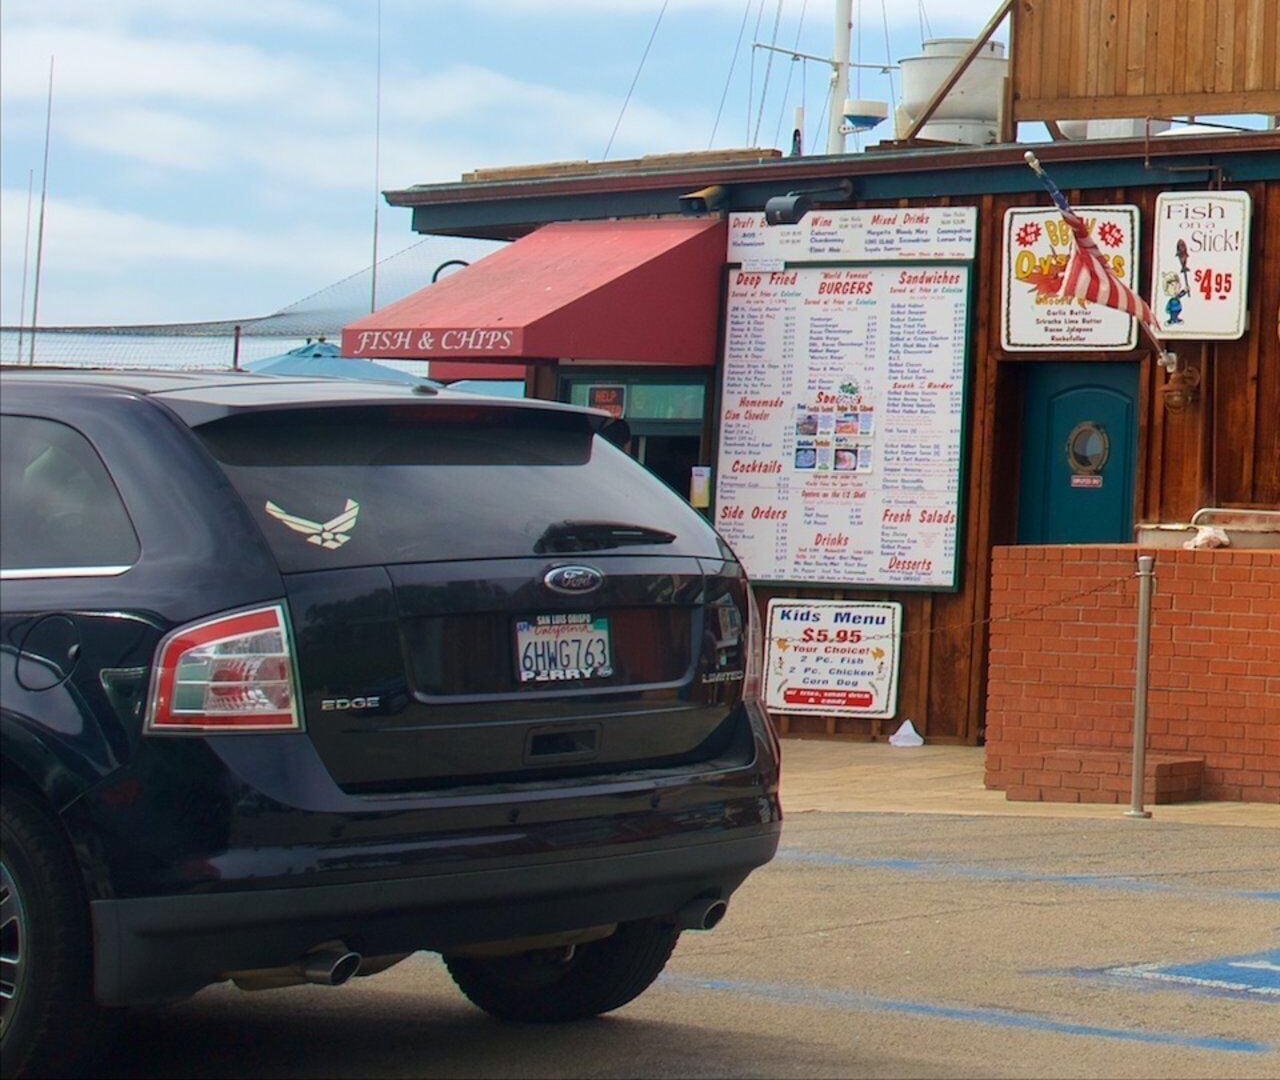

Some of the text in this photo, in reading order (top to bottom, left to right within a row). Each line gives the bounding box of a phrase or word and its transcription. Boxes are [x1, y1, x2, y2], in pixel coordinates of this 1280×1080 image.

[1167, 203, 1225, 219] Fish
[811, 218, 832, 226] Wine
[871, 215, 897, 225] Mixed
[903, 213, 929, 224] Drinks
[1190, 230, 1239, 252] Stick!
[736, 272, 797, 288] Deep Fried
[899, 271, 960, 284] Sandwiches
[818, 281, 873, 295] BURGERS
[354, 328, 513, 354] FISH & CHIPS
[739, 397, 784, 407] Homemade
[725, 410, 770, 420] Clam Chowder
[732, 460, 782, 473] Cocktails
[721, 506, 744, 519] Side
[752, 506, 787, 519] Orders
[882, 509, 955, 523] Fresh Salads
[815, 533, 849, 546] Drinks
[889, 556, 931, 570] Desserts
[781, 610, 886, 625] Kids Menu
[802, 628, 862, 643] $5.95
[523, 639, 606, 671] 6HWG763
[824, 646, 870, 655] Choice!
[521, 668, 594, 681] PERRY
[828, 668, 874, 676] Chicken
[321, 696, 380, 710] EDGE
